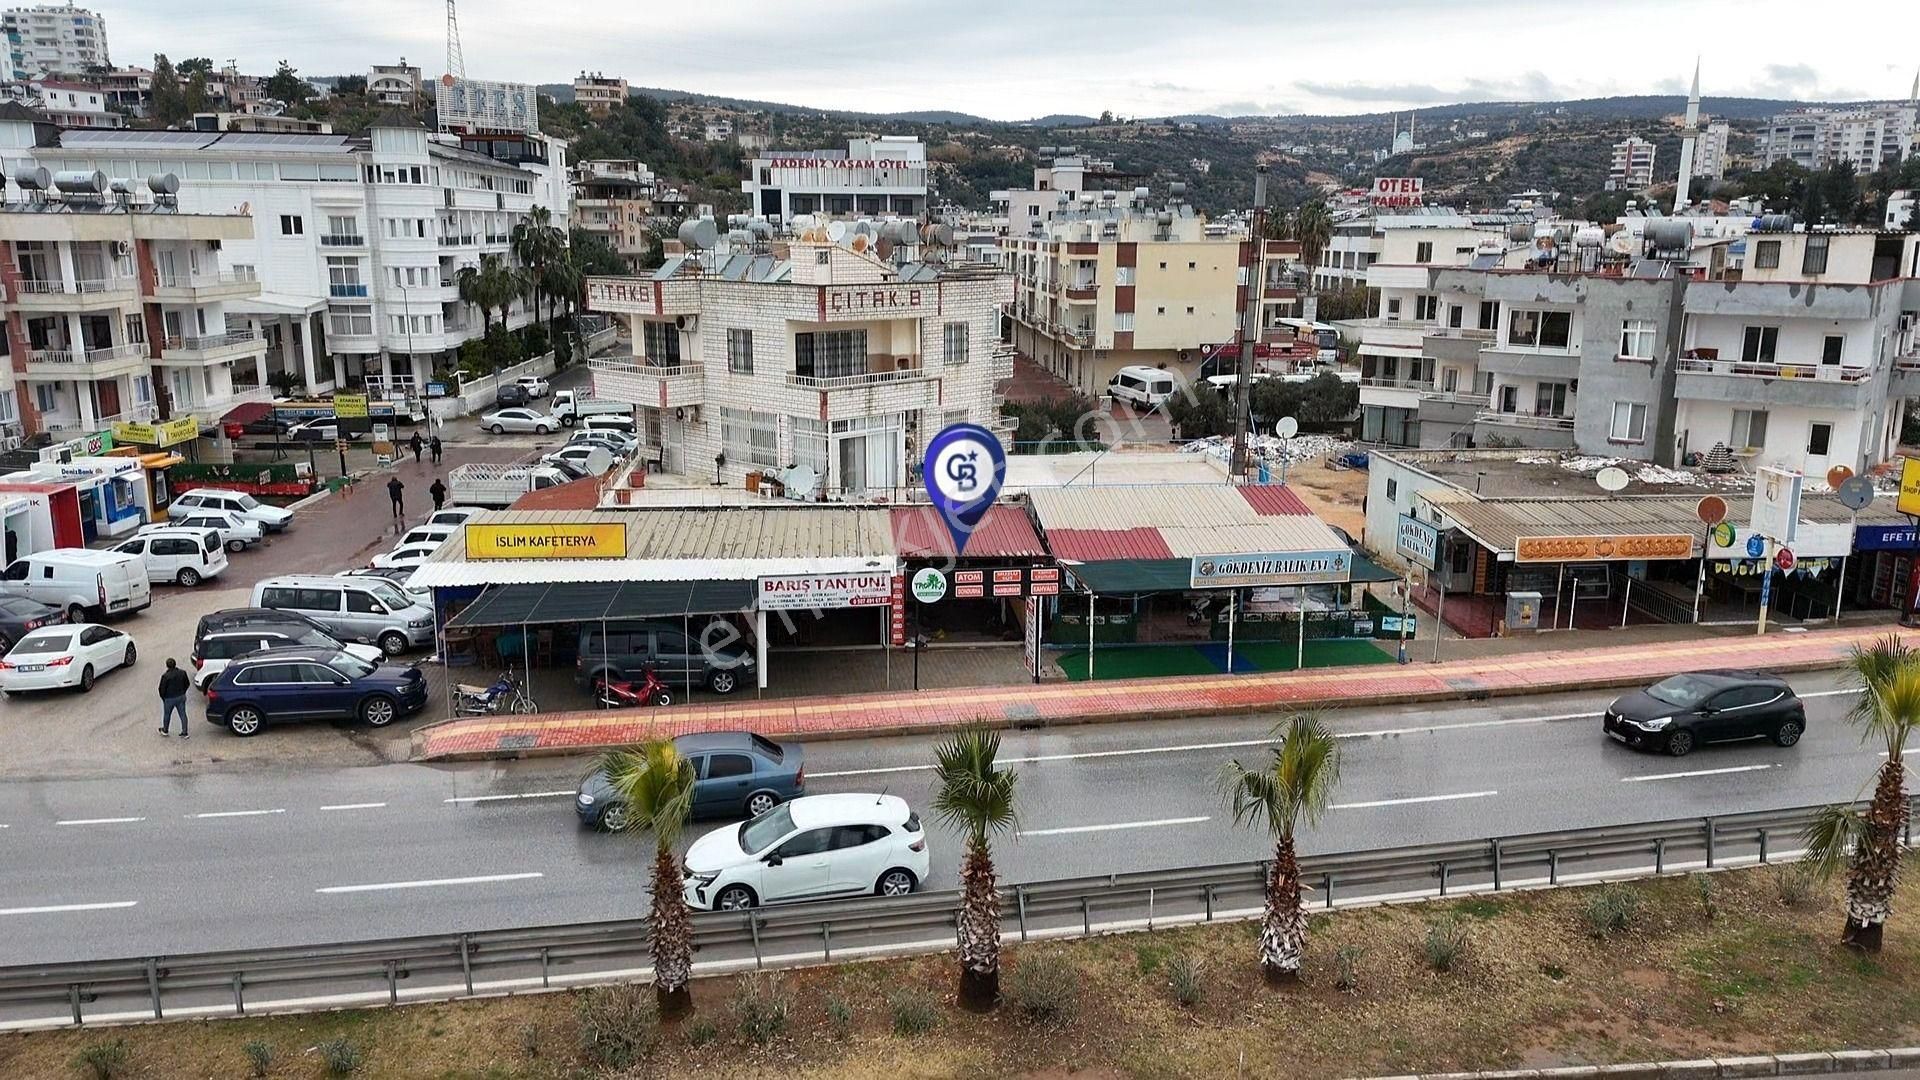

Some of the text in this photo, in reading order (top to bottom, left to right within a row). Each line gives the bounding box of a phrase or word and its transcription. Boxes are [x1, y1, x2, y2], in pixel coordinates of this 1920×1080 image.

[453, 84, 527, 116] EFES
[1379, 179, 1420, 192] OTEL
[495, 534, 596, 547] İSLİM KAFETERYA
[1882, 532, 1903, 542] EFE
[1218, 556, 1329, 574] GÖKDENİZ BALIK EVİ
[764, 574, 886, 593] BARIŞ TANTUNİ
[958, 574, 981, 582] ATOM
